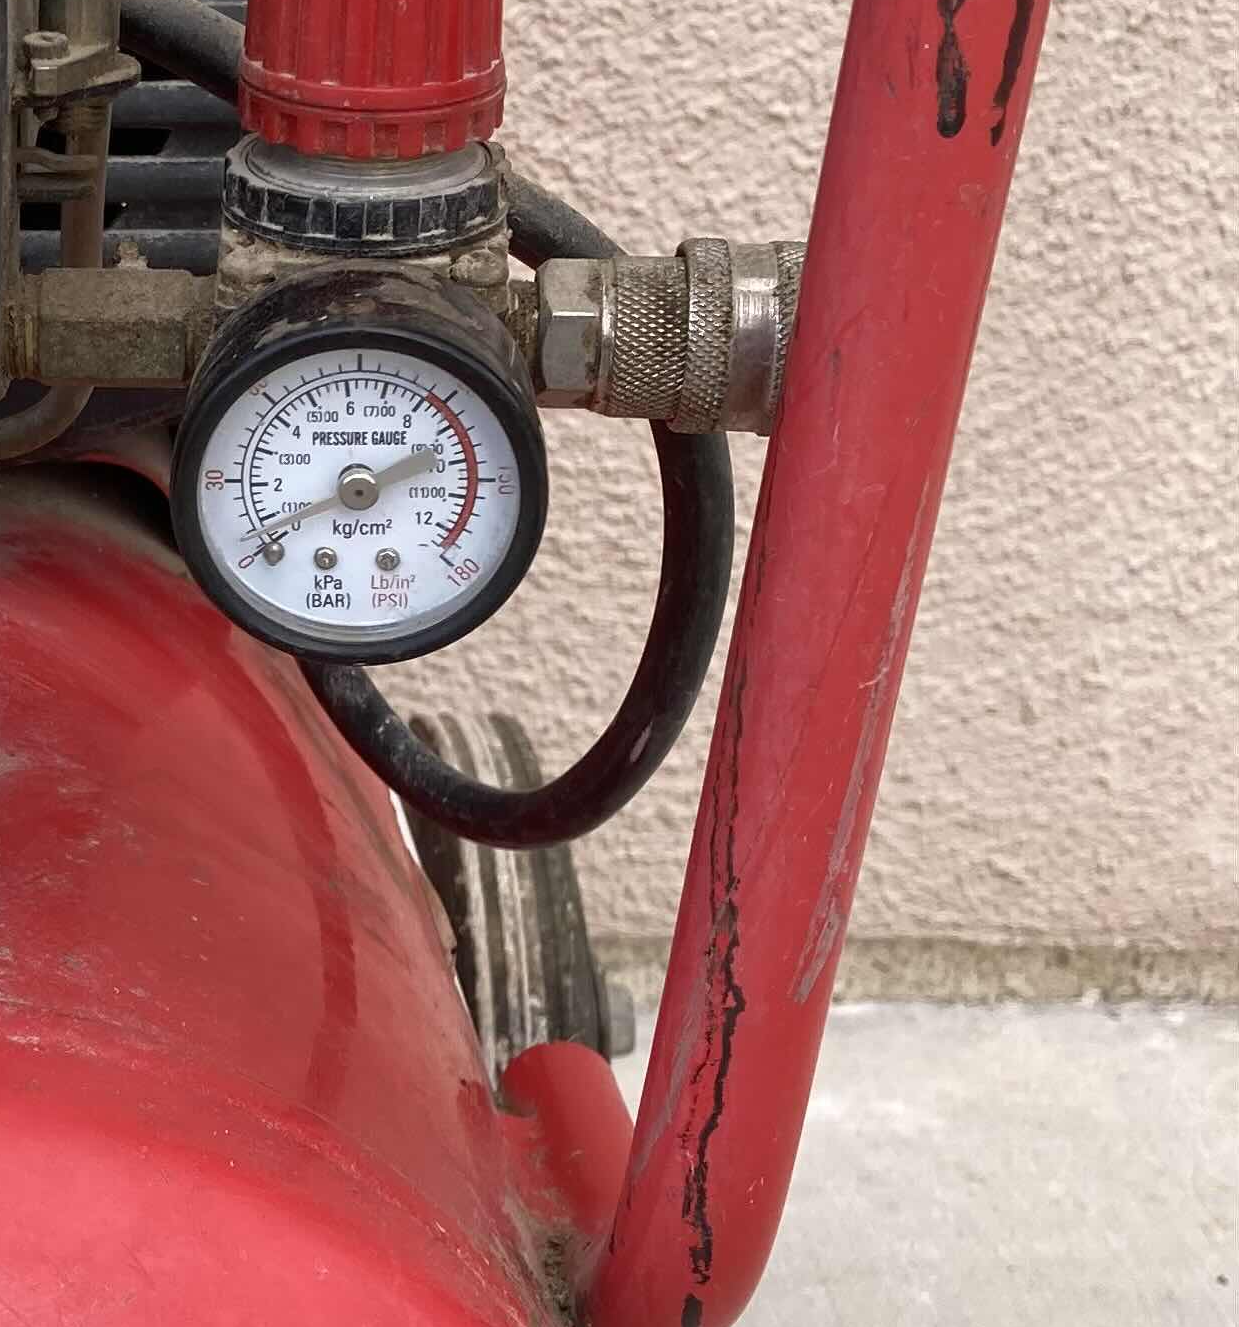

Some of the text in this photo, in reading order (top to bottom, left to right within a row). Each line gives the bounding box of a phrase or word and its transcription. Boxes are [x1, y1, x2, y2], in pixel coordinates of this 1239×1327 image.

[346, 401, 355, 416] 6
[363, 405, 396, 418] (7)00
[306, 410, 339, 423] (5)00
[402, 414, 412, 429] 8
[292, 425, 301, 440] 4
[312, 431, 407, 446] PRESSURE GAUGE
[279, 453, 311, 466] (3)00
[204, 469, 224, 491] 30
[273, 477, 283, 492] 2
[414, 511, 434, 526] 12
[238, 555, 255, 569] 0
[447, 558, 480, 588] 180
[313, 574, 344, 590] kPa
[305, 593, 352, 609] (BAR)
[372, 593, 409, 609] (PSI)
